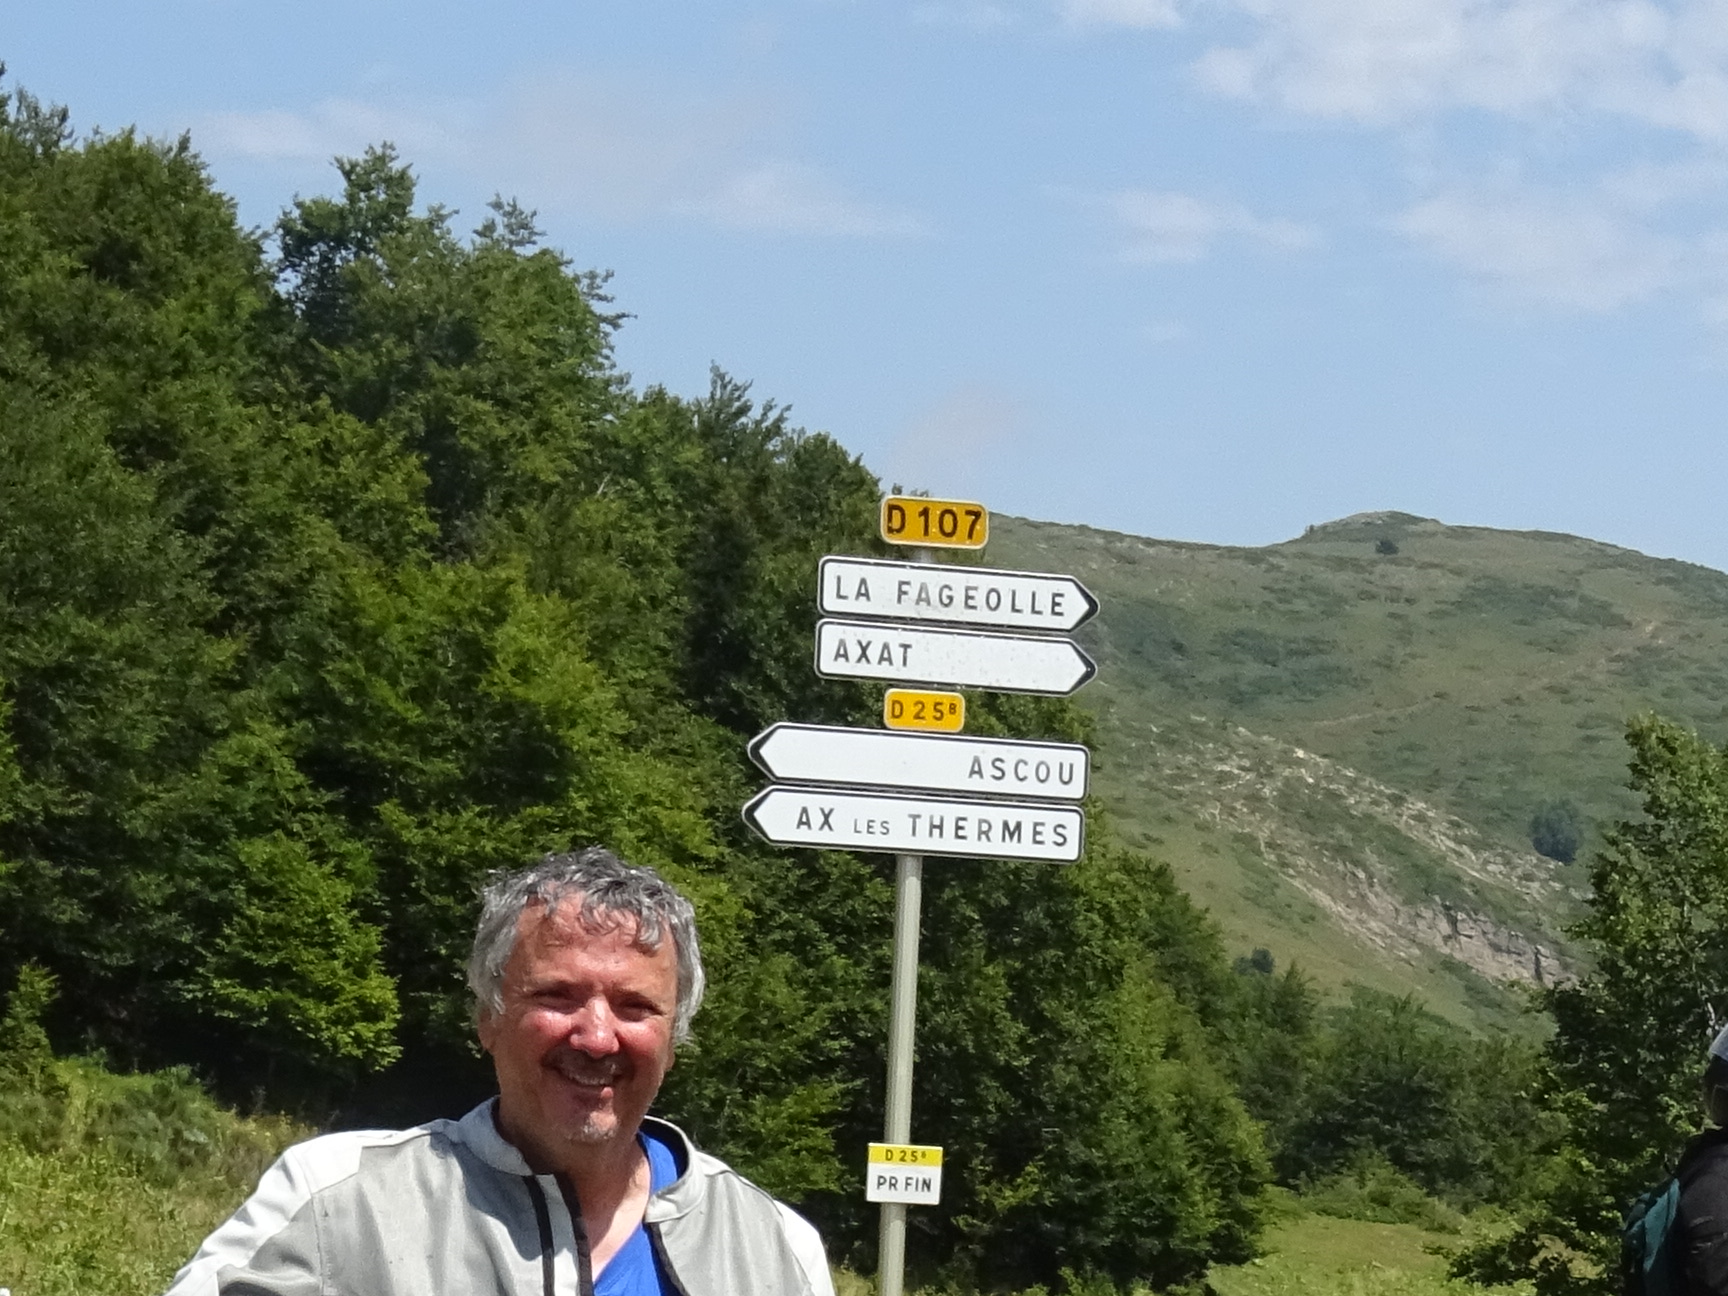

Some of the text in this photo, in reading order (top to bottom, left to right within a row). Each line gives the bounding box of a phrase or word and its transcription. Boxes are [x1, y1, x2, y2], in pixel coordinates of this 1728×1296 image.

[887, 504, 982, 540] D 107
[835, 575, 1065, 616] LA FAGEOLLE
[833, 638, 912, 667] AXAT
[891, 699, 904, 719] D
[968, 755, 1074, 786] ASCOU
[796, 806, 1068, 847] AX LES THERMES
[885, 1149, 893, 1161] D
[876, 1175, 932, 1193] PR FIN
